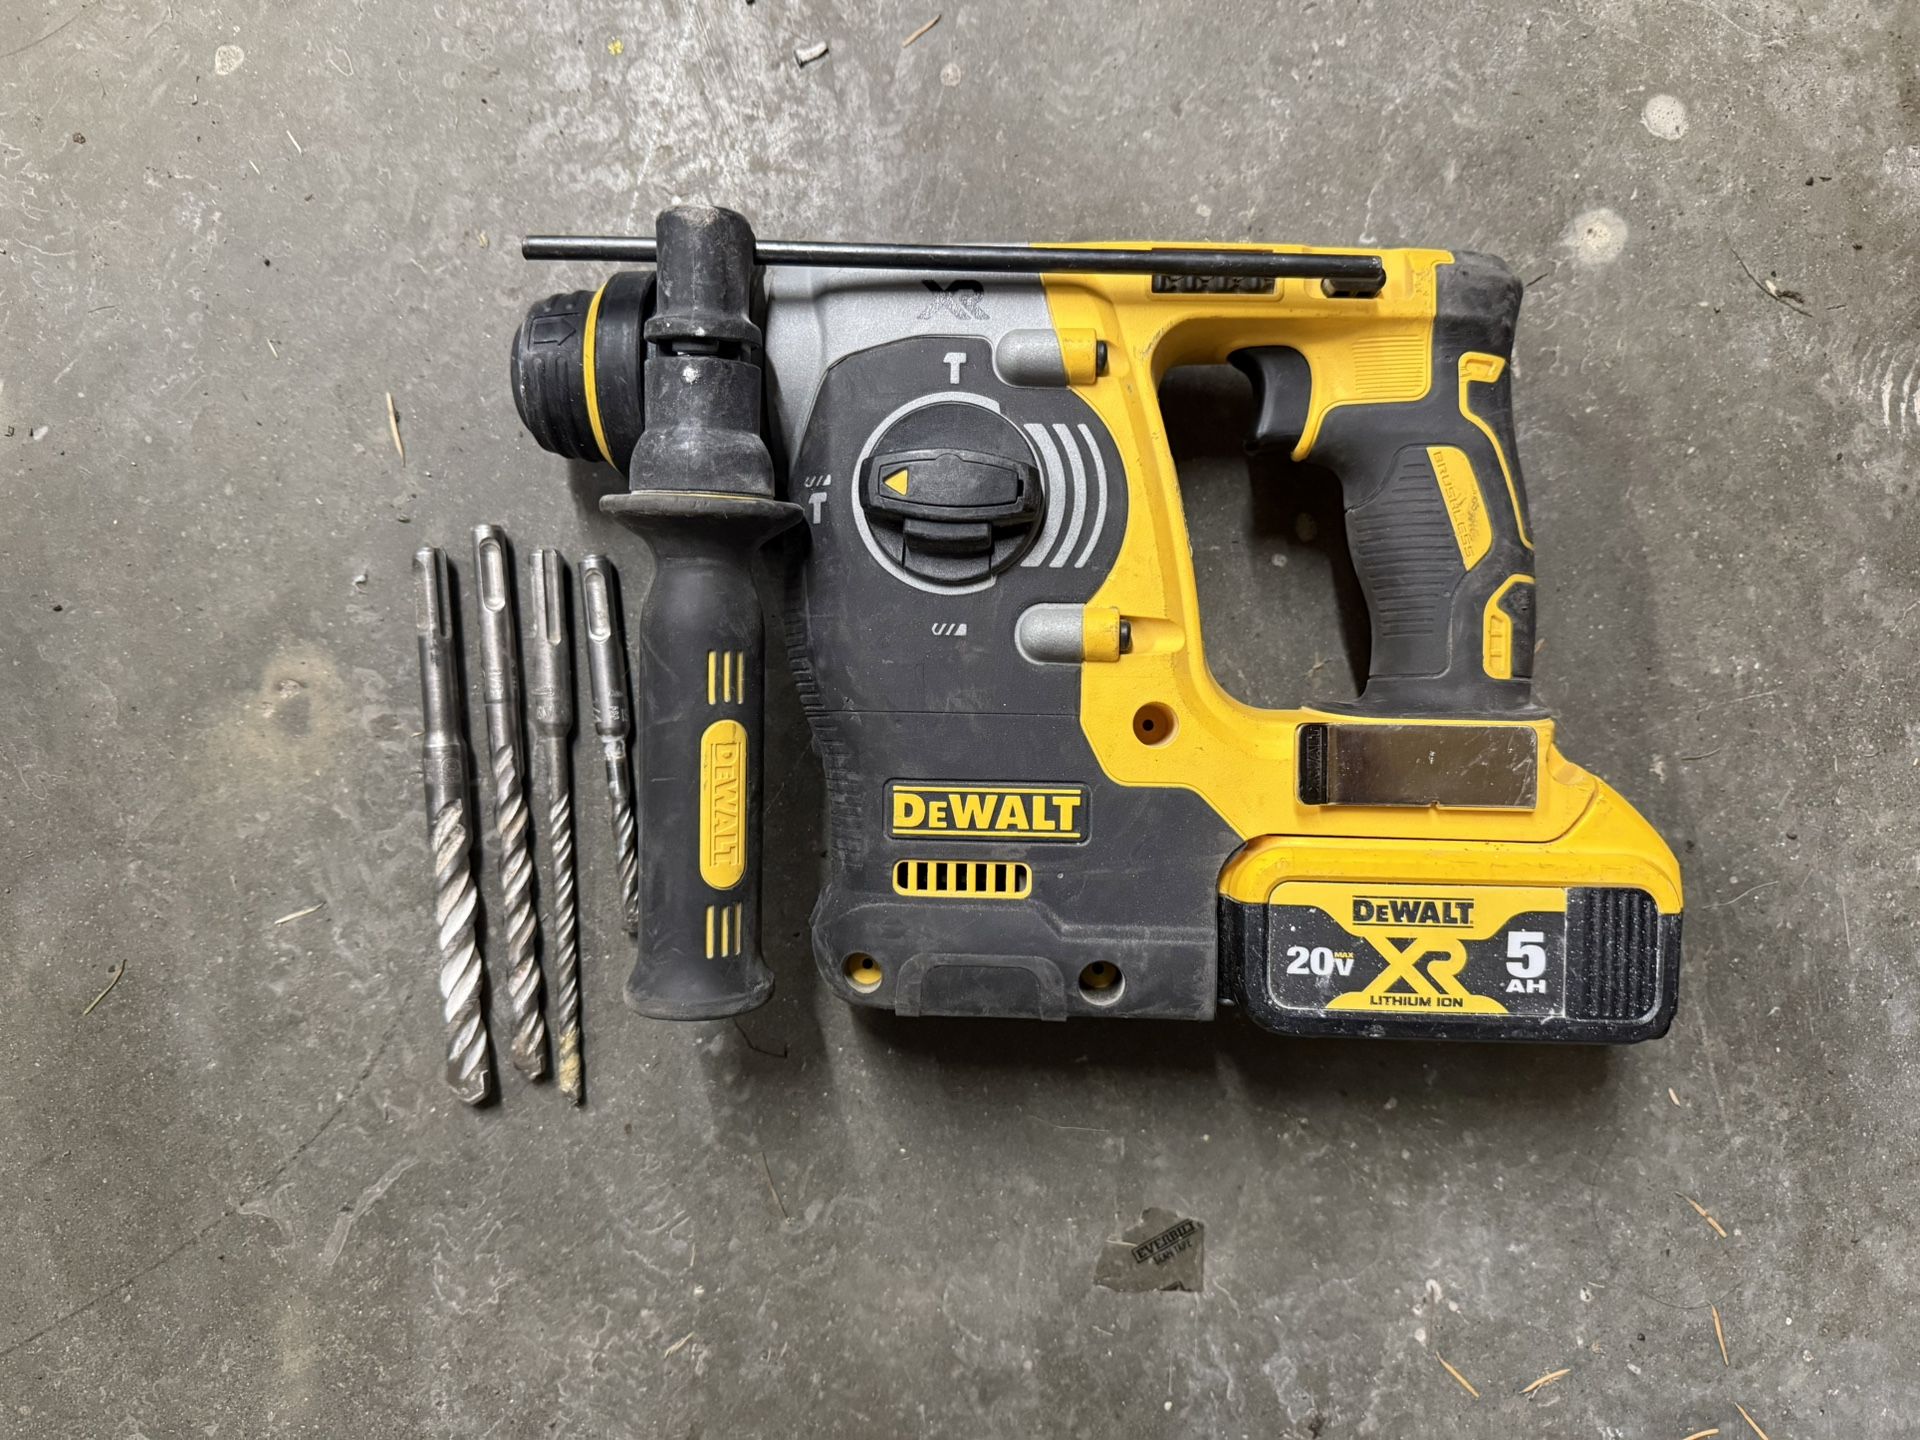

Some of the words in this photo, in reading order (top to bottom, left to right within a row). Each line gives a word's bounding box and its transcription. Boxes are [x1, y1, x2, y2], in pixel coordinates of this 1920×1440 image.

[916, 279, 991, 321] XR
[1362, 935, 1470, 994] XR
[1505, 930, 1546, 979] 5
[1370, 994, 1432, 1007] LITHIUM
[1435, 995, 1464, 1008] ION
[1505, 979, 1546, 994] AH
